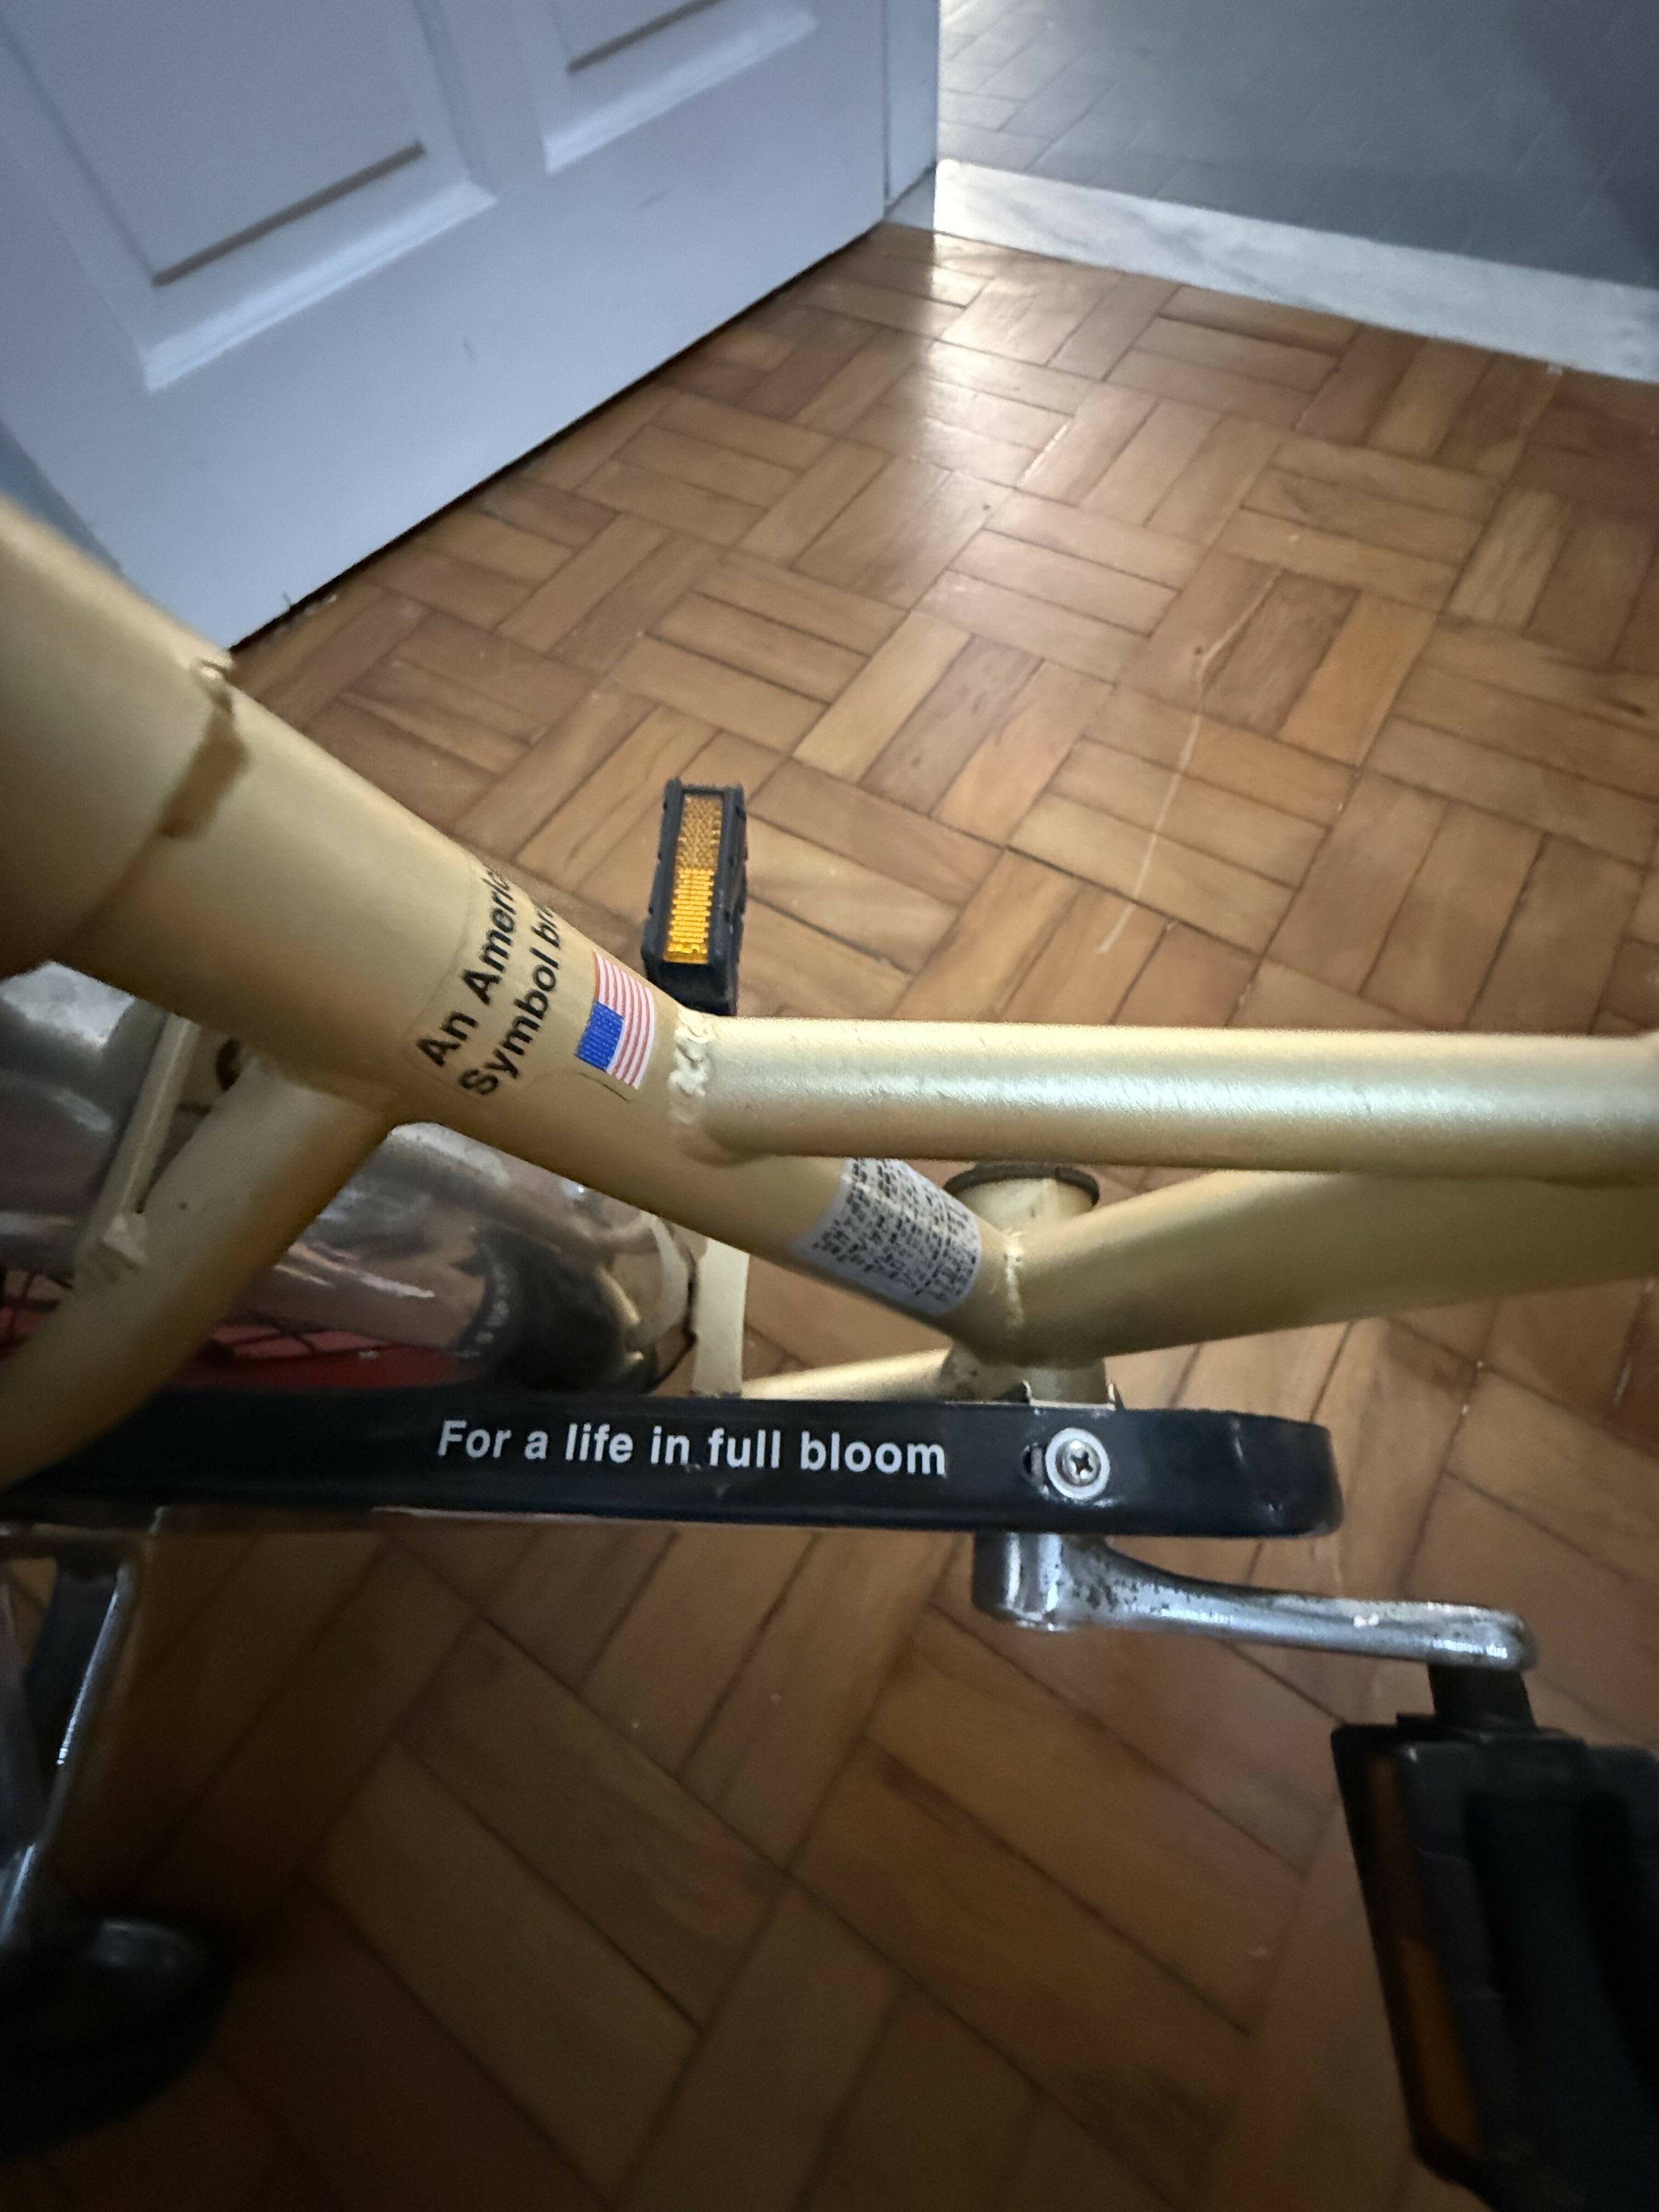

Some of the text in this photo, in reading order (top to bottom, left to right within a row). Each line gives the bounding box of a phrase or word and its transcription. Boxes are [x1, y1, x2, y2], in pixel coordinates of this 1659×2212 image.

[416, 1011, 480, 1067] An
[459, 946, 560, 1096] Symbol
[438, 1419, 946, 1476] For a life in full bloom
